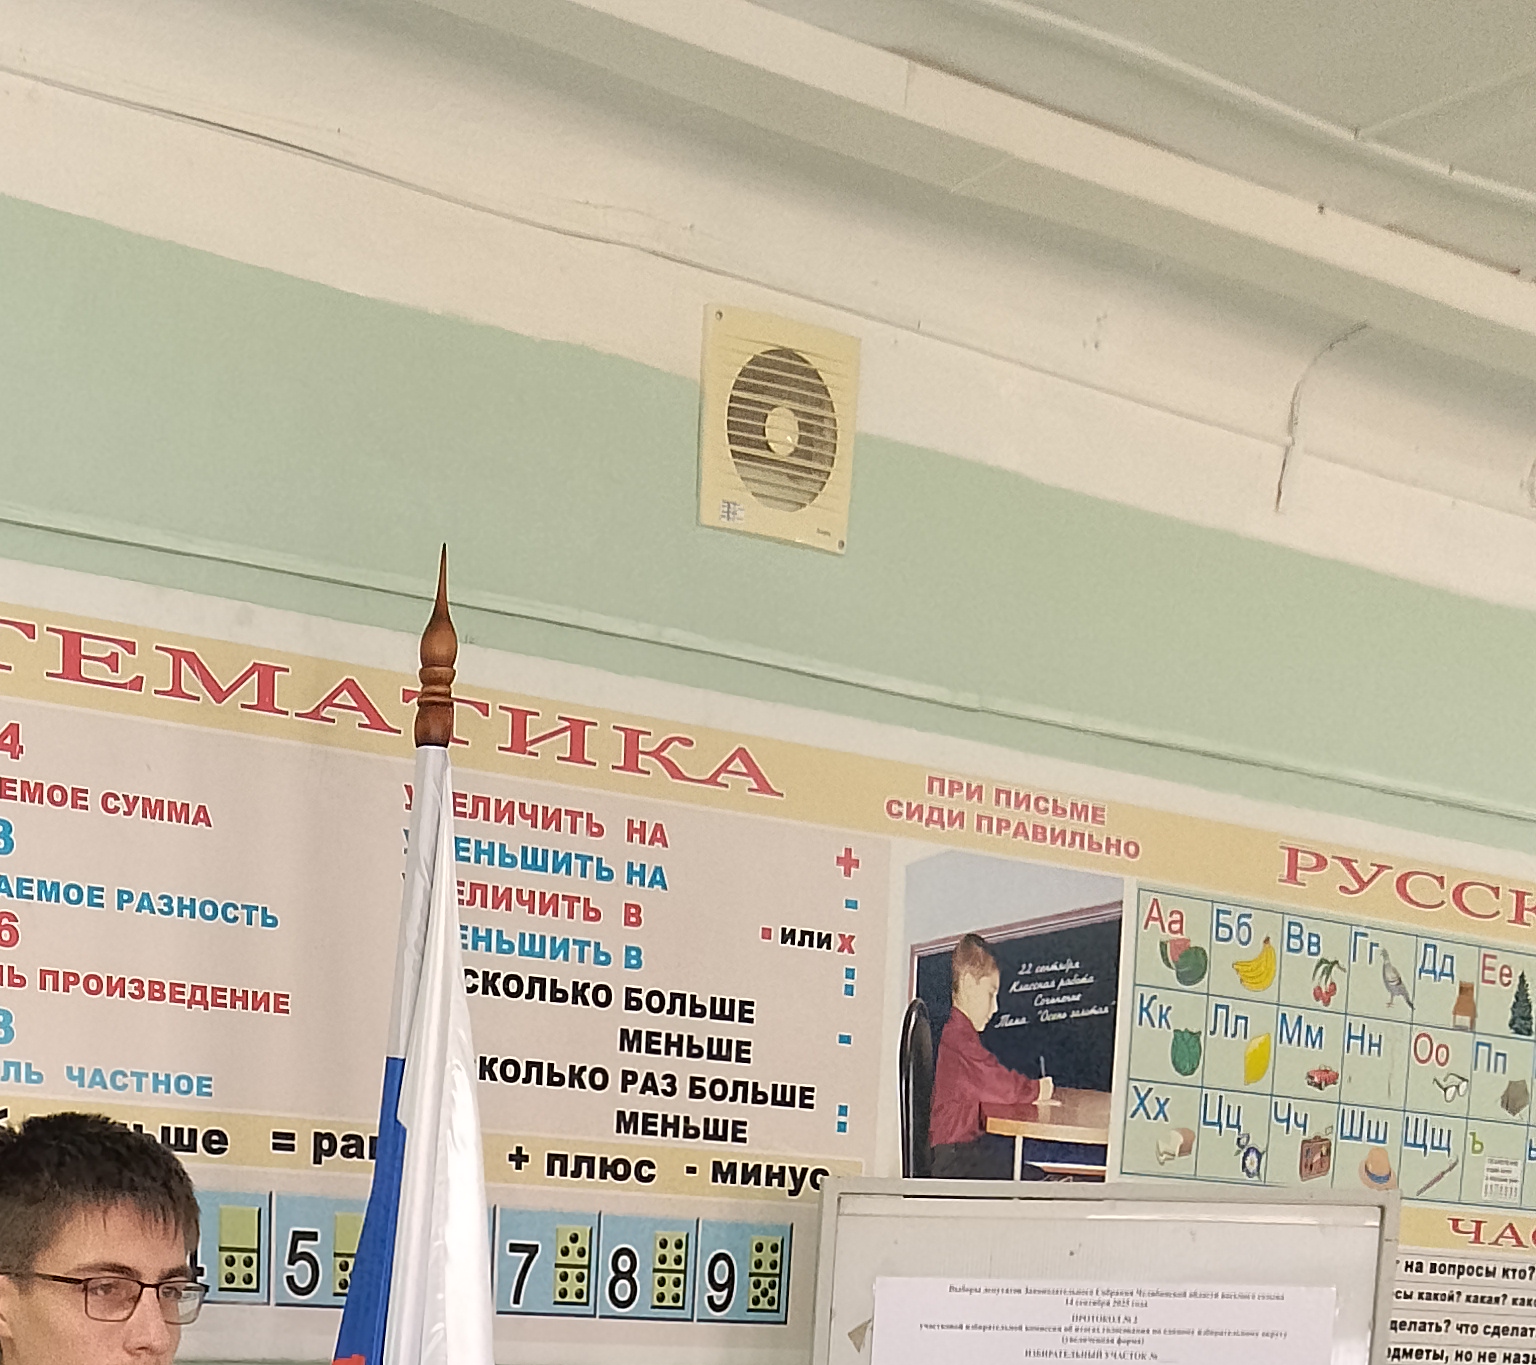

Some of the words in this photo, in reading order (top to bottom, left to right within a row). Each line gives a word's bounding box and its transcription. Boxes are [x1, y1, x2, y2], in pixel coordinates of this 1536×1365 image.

[100, 790, 213, 829] СУММА
[403, 784, 606, 839] ЕЛИЧИТЬ
[625, 818, 670, 849] НА
[926, 774, 984, 805] ПРИ
[994, 786, 1106, 827] ПИСЬМЕ
[885, 798, 966, 831] СИДИ
[975, 812, 1141, 860] ПРАВИЛЬНО
[403, 828, 616, 883] ЕНЬШИТЬ
[625, 860, 670, 892] НА
[115, 887, 280, 929] РАЗНОСТЬ
[623, 902, 644, 929] В
[1143, 897, 1185, 936] Аа
[1214, 907, 1253, 947] Бб
[623, 944, 645, 971] В
[1285, 920, 1322, 957] Вв
[1351, 930, 1381, 965] Гг
[1017, 962, 1033, 976] 22
[1418, 943, 1456, 983] Дд
[1480, 952, 1514, 988] Ее
[37, 968, 292, 1015] ПРОИЗВЕДЕНИЕ
[623, 986, 756, 1025] БОЛЬШЕ
[1137, 992, 1173, 1031] Кк
[1208, 1002, 1250, 1040] Лл
[1278, 1011, 1325, 1050] Мм
[618, 1027, 753, 1065] МЕНЬШЕ
[1346, 1021, 1383, 1058] Нн
[1412, 1031, 1451, 1068] Оо
[1473, 1040, 1508, 1075] Пп
[64, 1064, 214, 1099] ЧАСТНОЕ
[475, 1055, 610, 1093] КОЛЬКО
[619, 1069, 678, 1099] РАЗ
[687, 1075, 816, 1111] БОЛЬШЕ
[1129, 1085, 1172, 1123] Хх
[1202, 1092, 1243, 1137] Цц
[1273, 1100, 1310, 1137] Чч
[614, 1109, 749, 1144] МЕНЬШЕ
[1339, 1107, 1390, 1144] Шш
[1403, 1115, 1453, 1157] Щщ
[545, 1152, 657, 1184] плюс
[710, 1159, 831, 1198] минус
[1446, 1216, 1536, 1249] ЧА
[284, 1229, 321, 1297] 5
[507, 1241, 541, 1306] 7
[607, 1246, 639, 1311] 8
[1403, 1259, 1425, 1274] на
[1428, 1261, 1497, 1280] вопросы
[1501, 1265, 1536, 1281] кто?
[705, 1251, 736, 1314] 9
[1417, 1290, 1462, 1302] какой?
[1464, 1293, 1508, 1306] какая?
[1455, 1322, 1479, 1335] что
[1454, 1349, 1473, 1362] но
[1477, 1351, 1497, 1363] не
